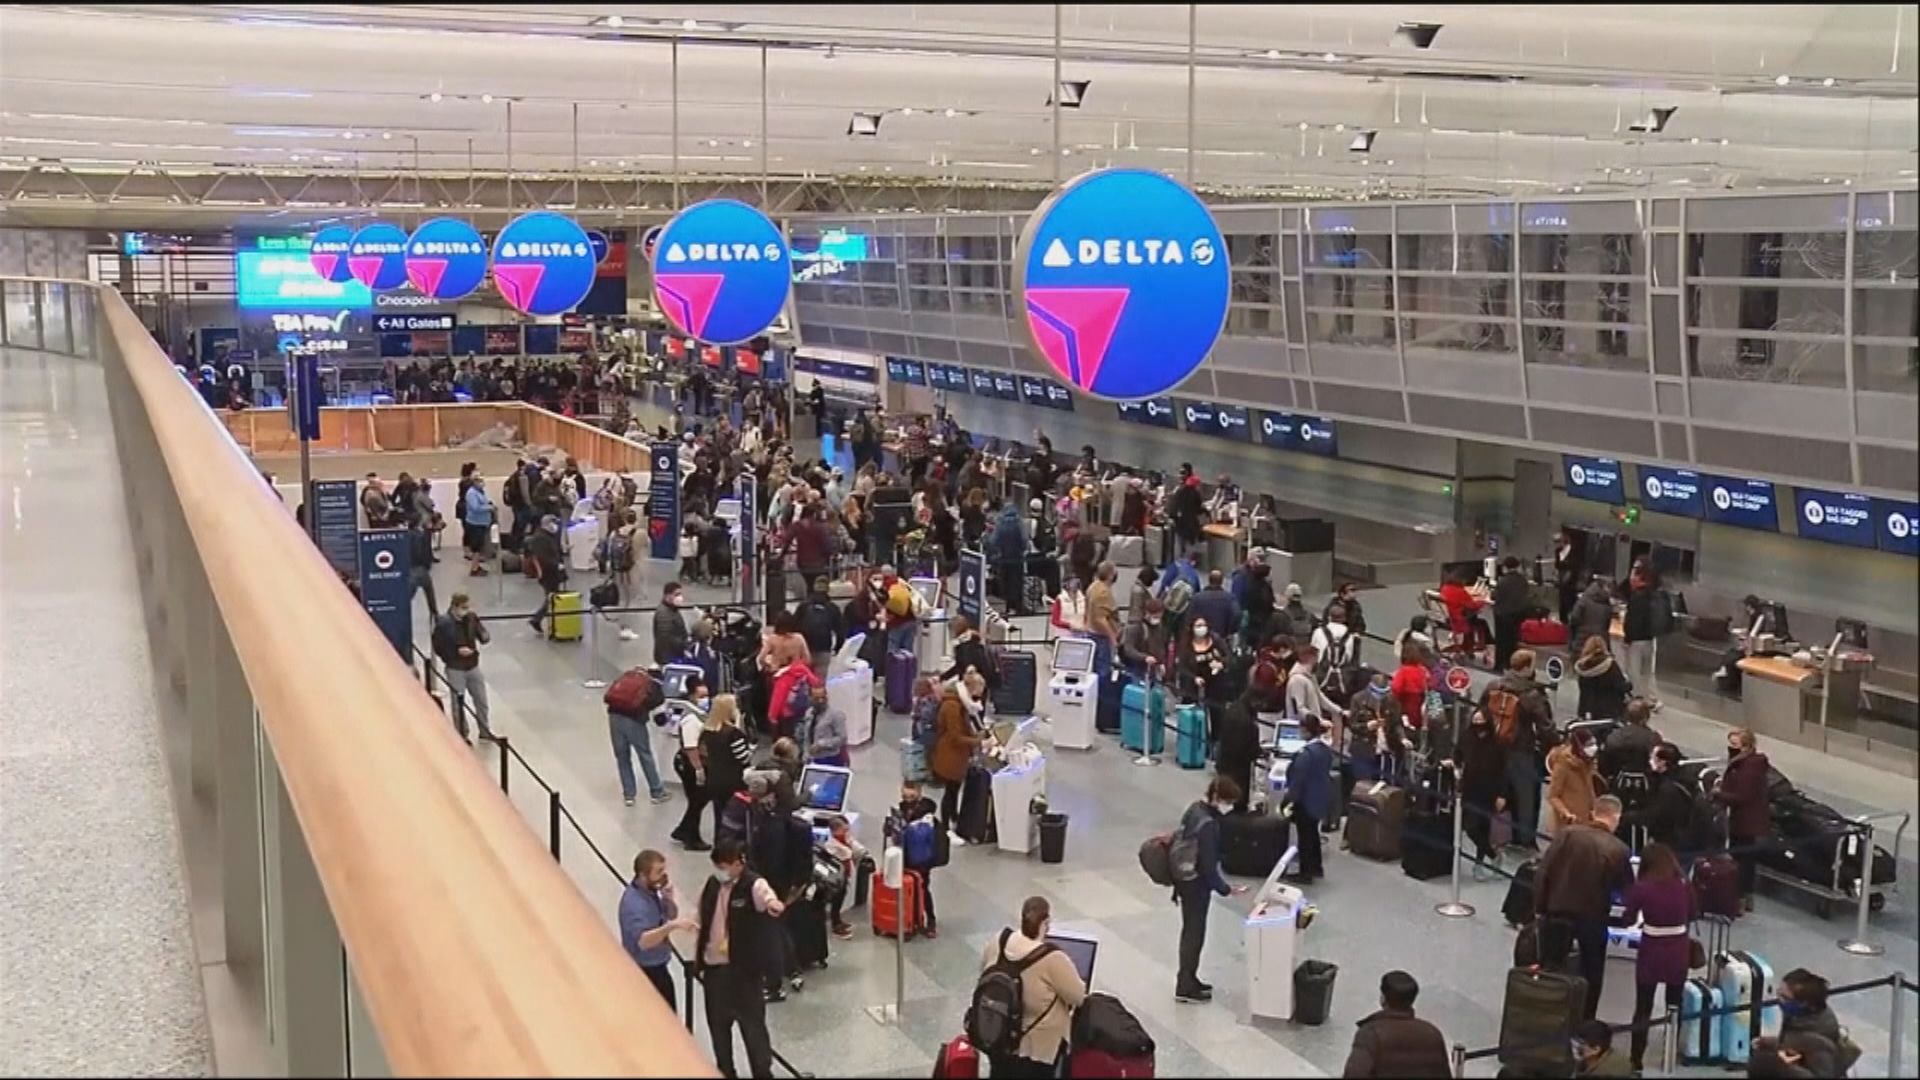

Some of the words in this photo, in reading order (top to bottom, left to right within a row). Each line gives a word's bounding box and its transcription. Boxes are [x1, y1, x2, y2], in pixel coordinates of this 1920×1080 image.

[426, 242, 470, 254] DELTA
[517, 243, 572, 257] DELTA
[688, 243, 761, 262] DELTA
[1078, 239, 1185, 265] DELTA
[391, 317, 405, 330] All
[407, 317, 441, 330] Gates
